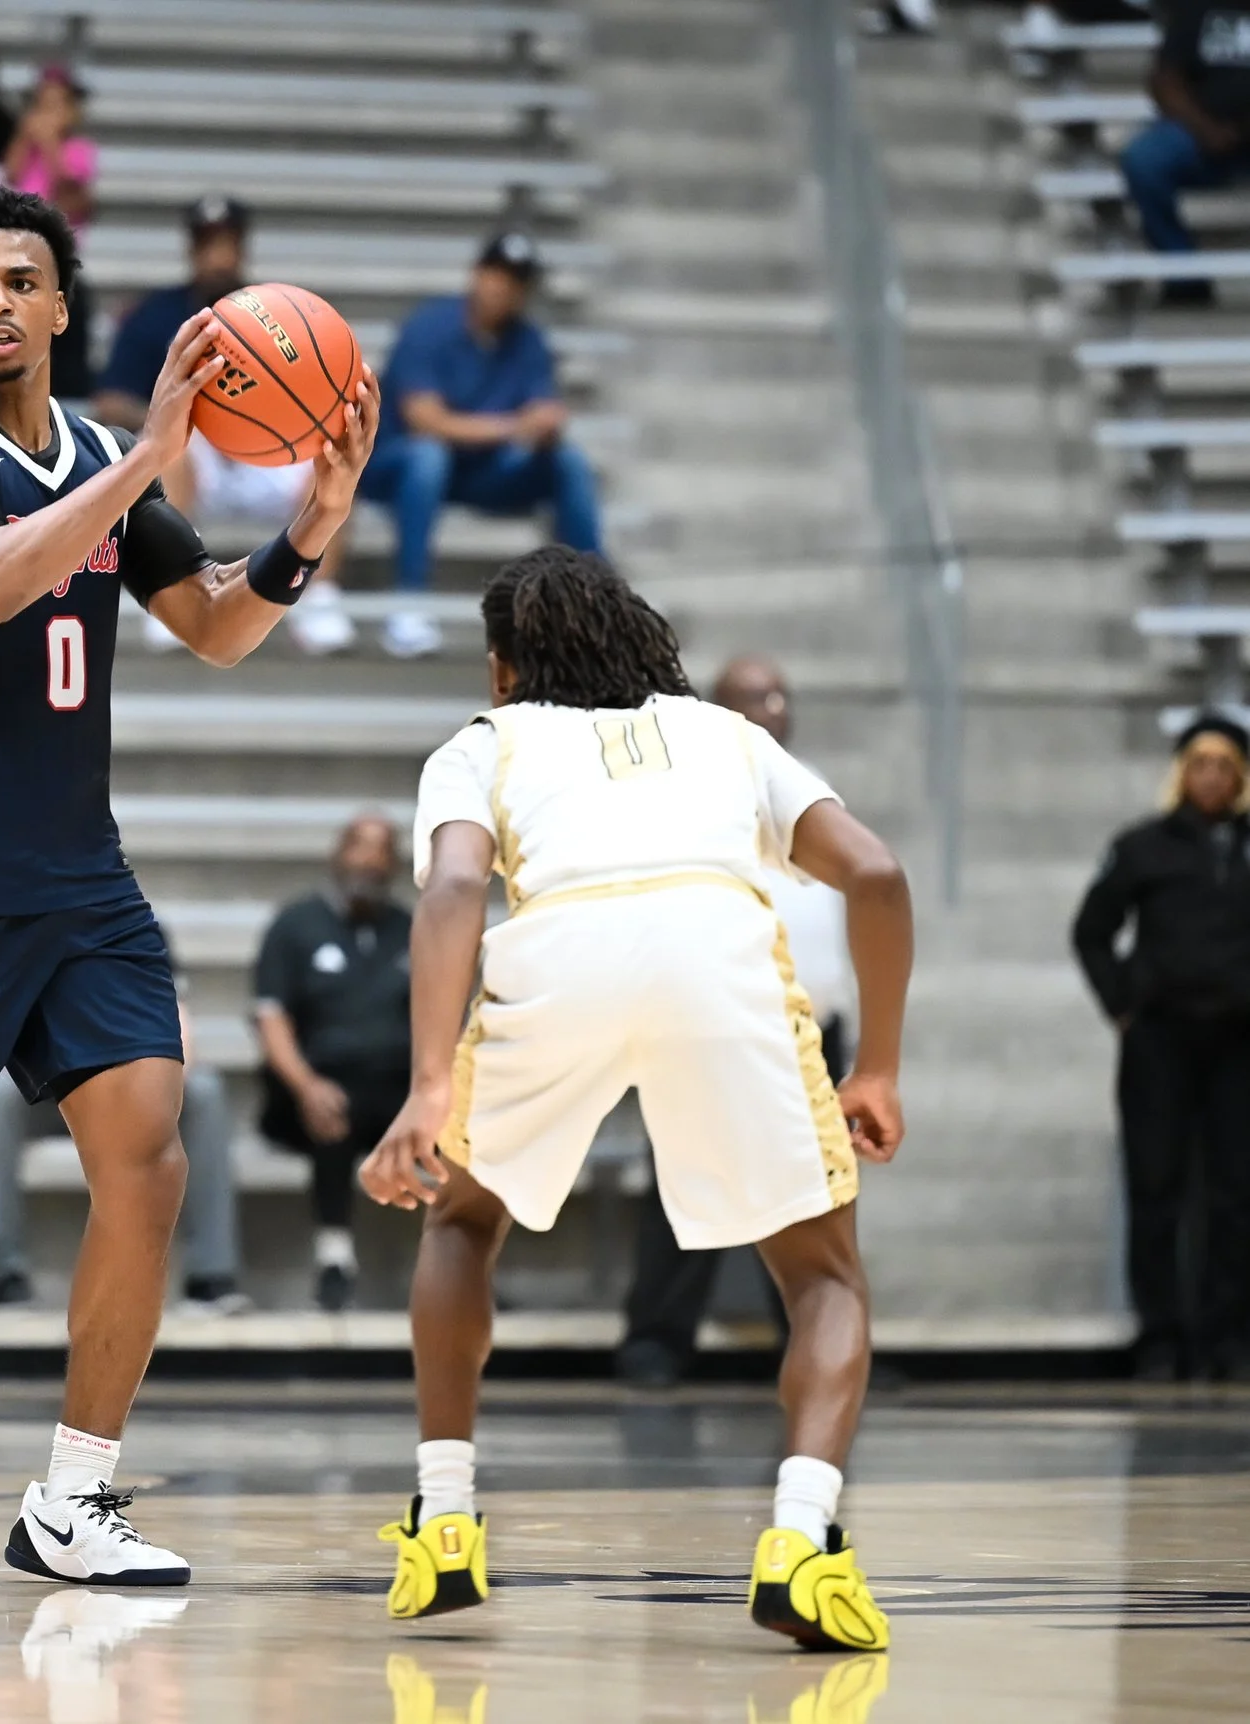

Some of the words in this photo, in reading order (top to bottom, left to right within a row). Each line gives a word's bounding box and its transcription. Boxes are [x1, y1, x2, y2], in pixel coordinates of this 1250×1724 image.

[245, 297, 299, 365] ELITE
[46, 615, 87, 711] 0
[60, 1428, 112, 1451] Supreme
